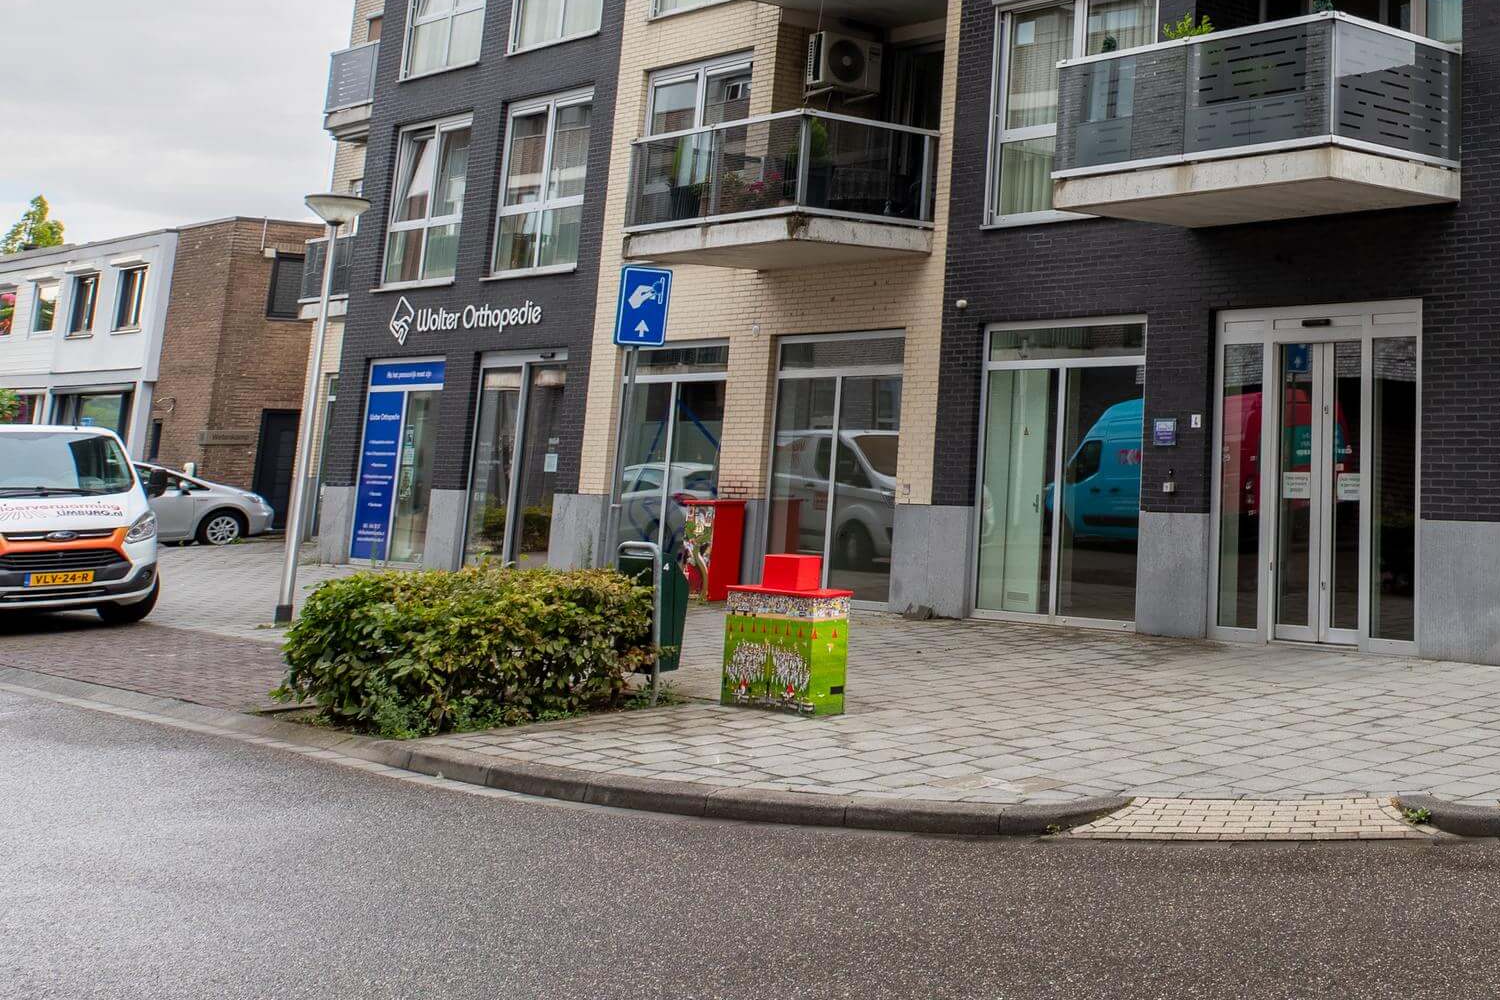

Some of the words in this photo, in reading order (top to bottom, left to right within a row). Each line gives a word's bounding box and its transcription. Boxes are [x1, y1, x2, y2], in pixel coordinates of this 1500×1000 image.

[417, 306, 461, 332] Wolter
[462, 300, 542, 333] Orthopedie
[663, 563, 669, 571] 4
[35, 572, 89, 585] VLV-24-R
